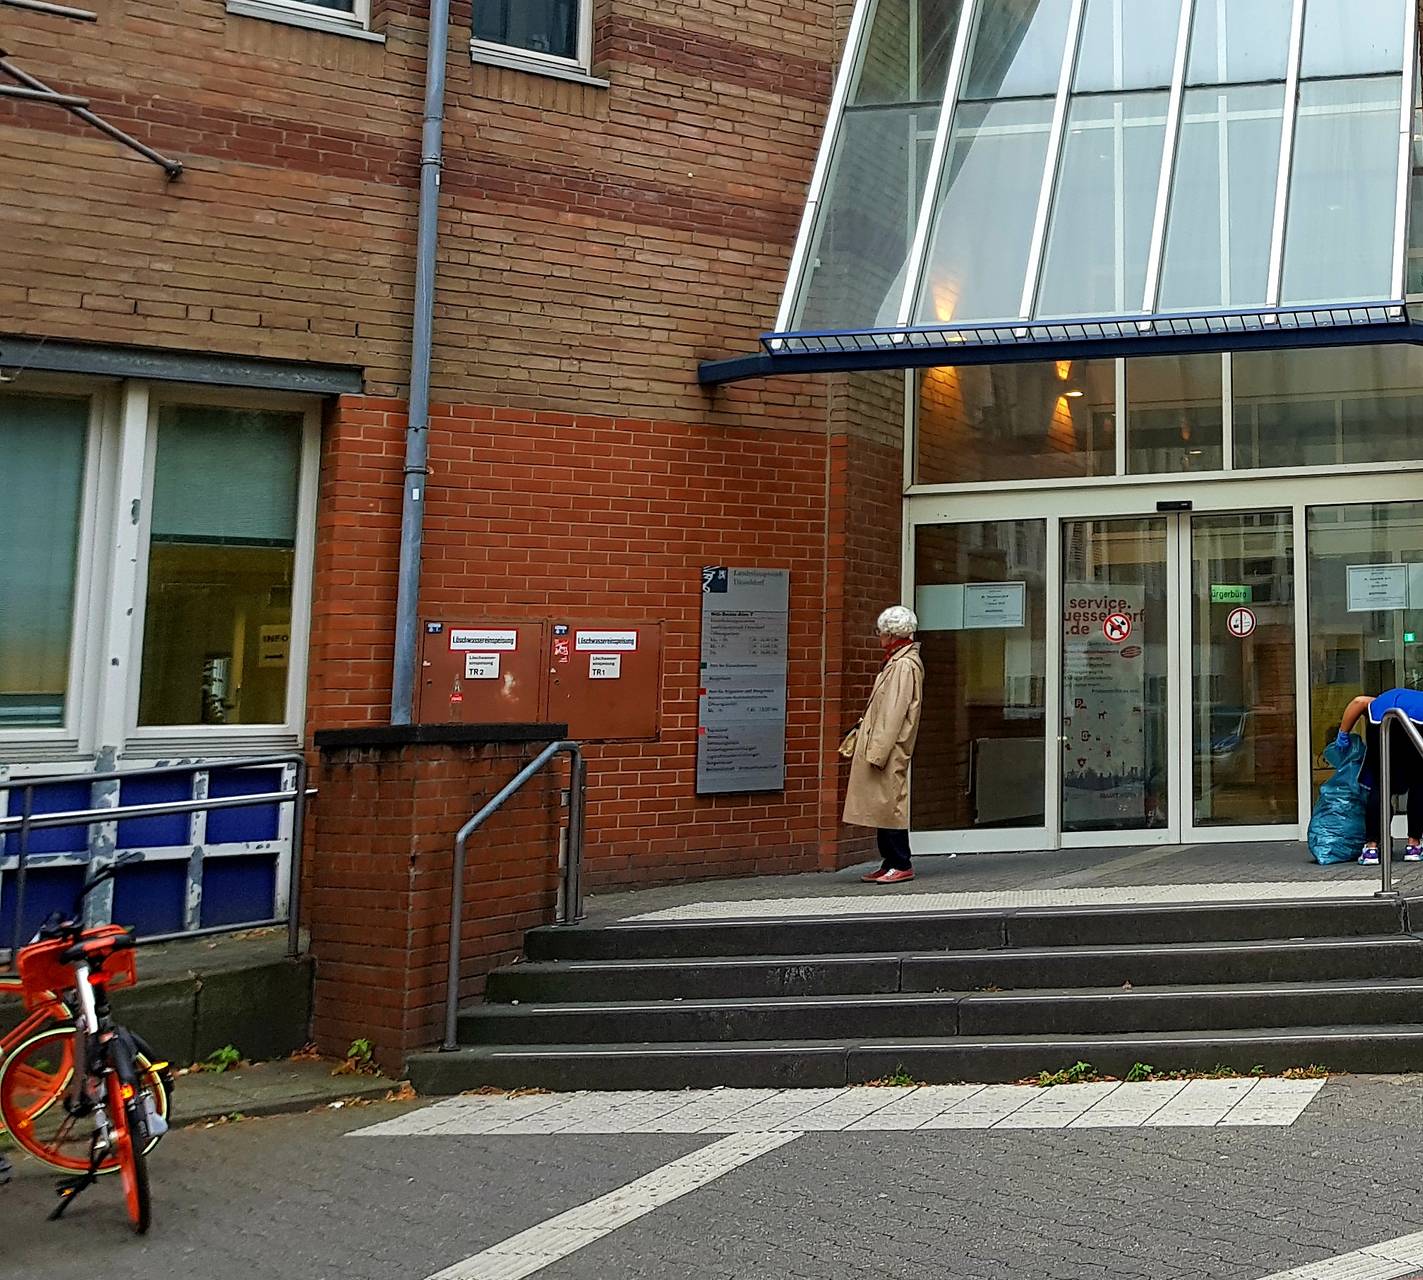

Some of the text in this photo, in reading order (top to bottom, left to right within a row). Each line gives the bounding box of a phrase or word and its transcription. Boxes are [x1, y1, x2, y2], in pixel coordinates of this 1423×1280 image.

[1070, 595, 1131, 609] service.
[1063, 608, 1145, 622] uesseorf
[1066, 622, 1090, 635] .de
